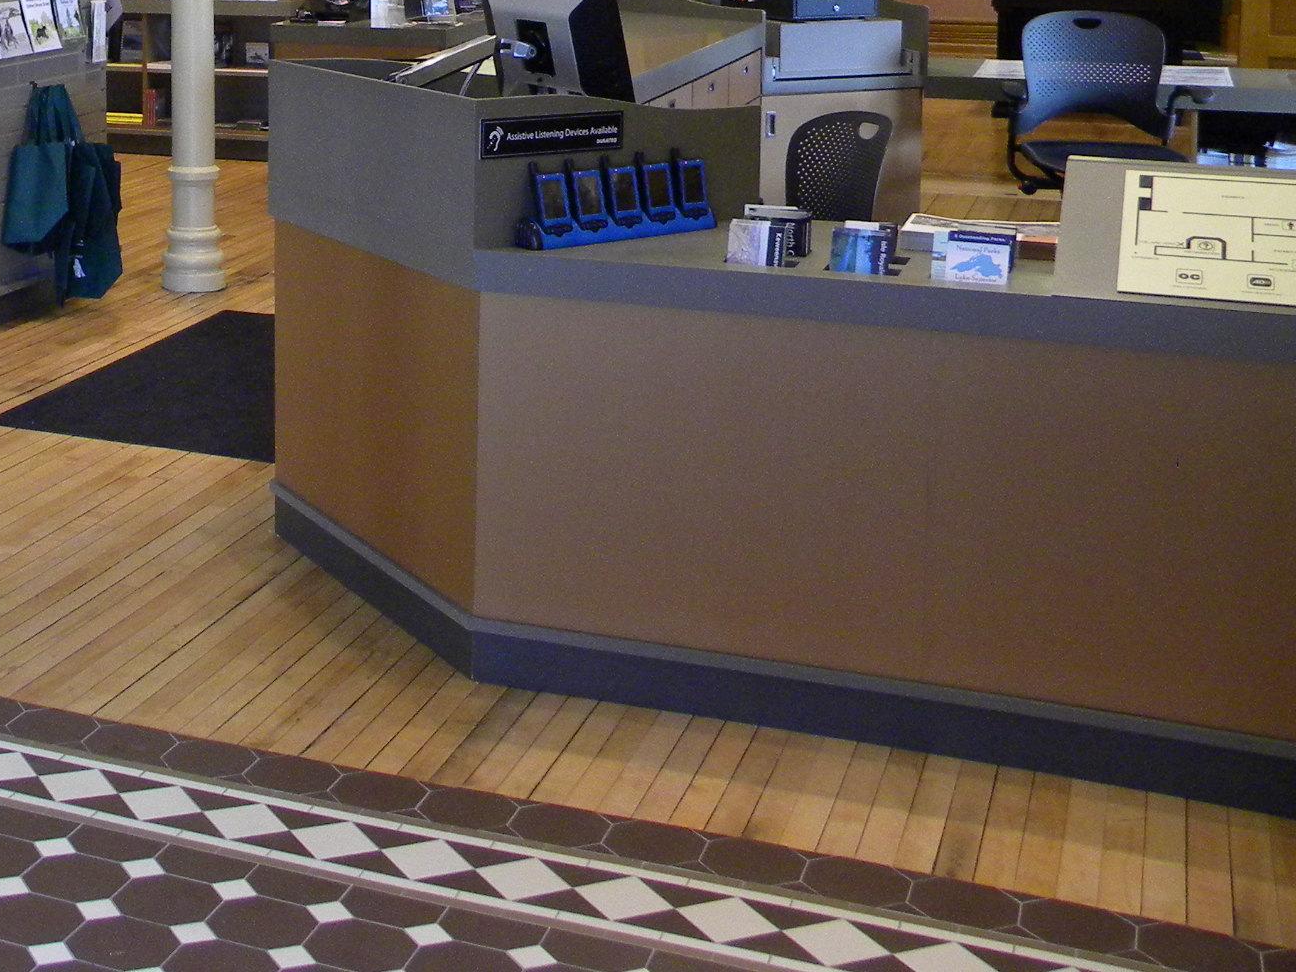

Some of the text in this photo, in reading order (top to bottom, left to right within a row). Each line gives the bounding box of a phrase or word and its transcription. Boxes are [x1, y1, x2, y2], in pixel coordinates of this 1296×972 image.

[507, 125, 618, 141] Assistive Listening Devices Available
